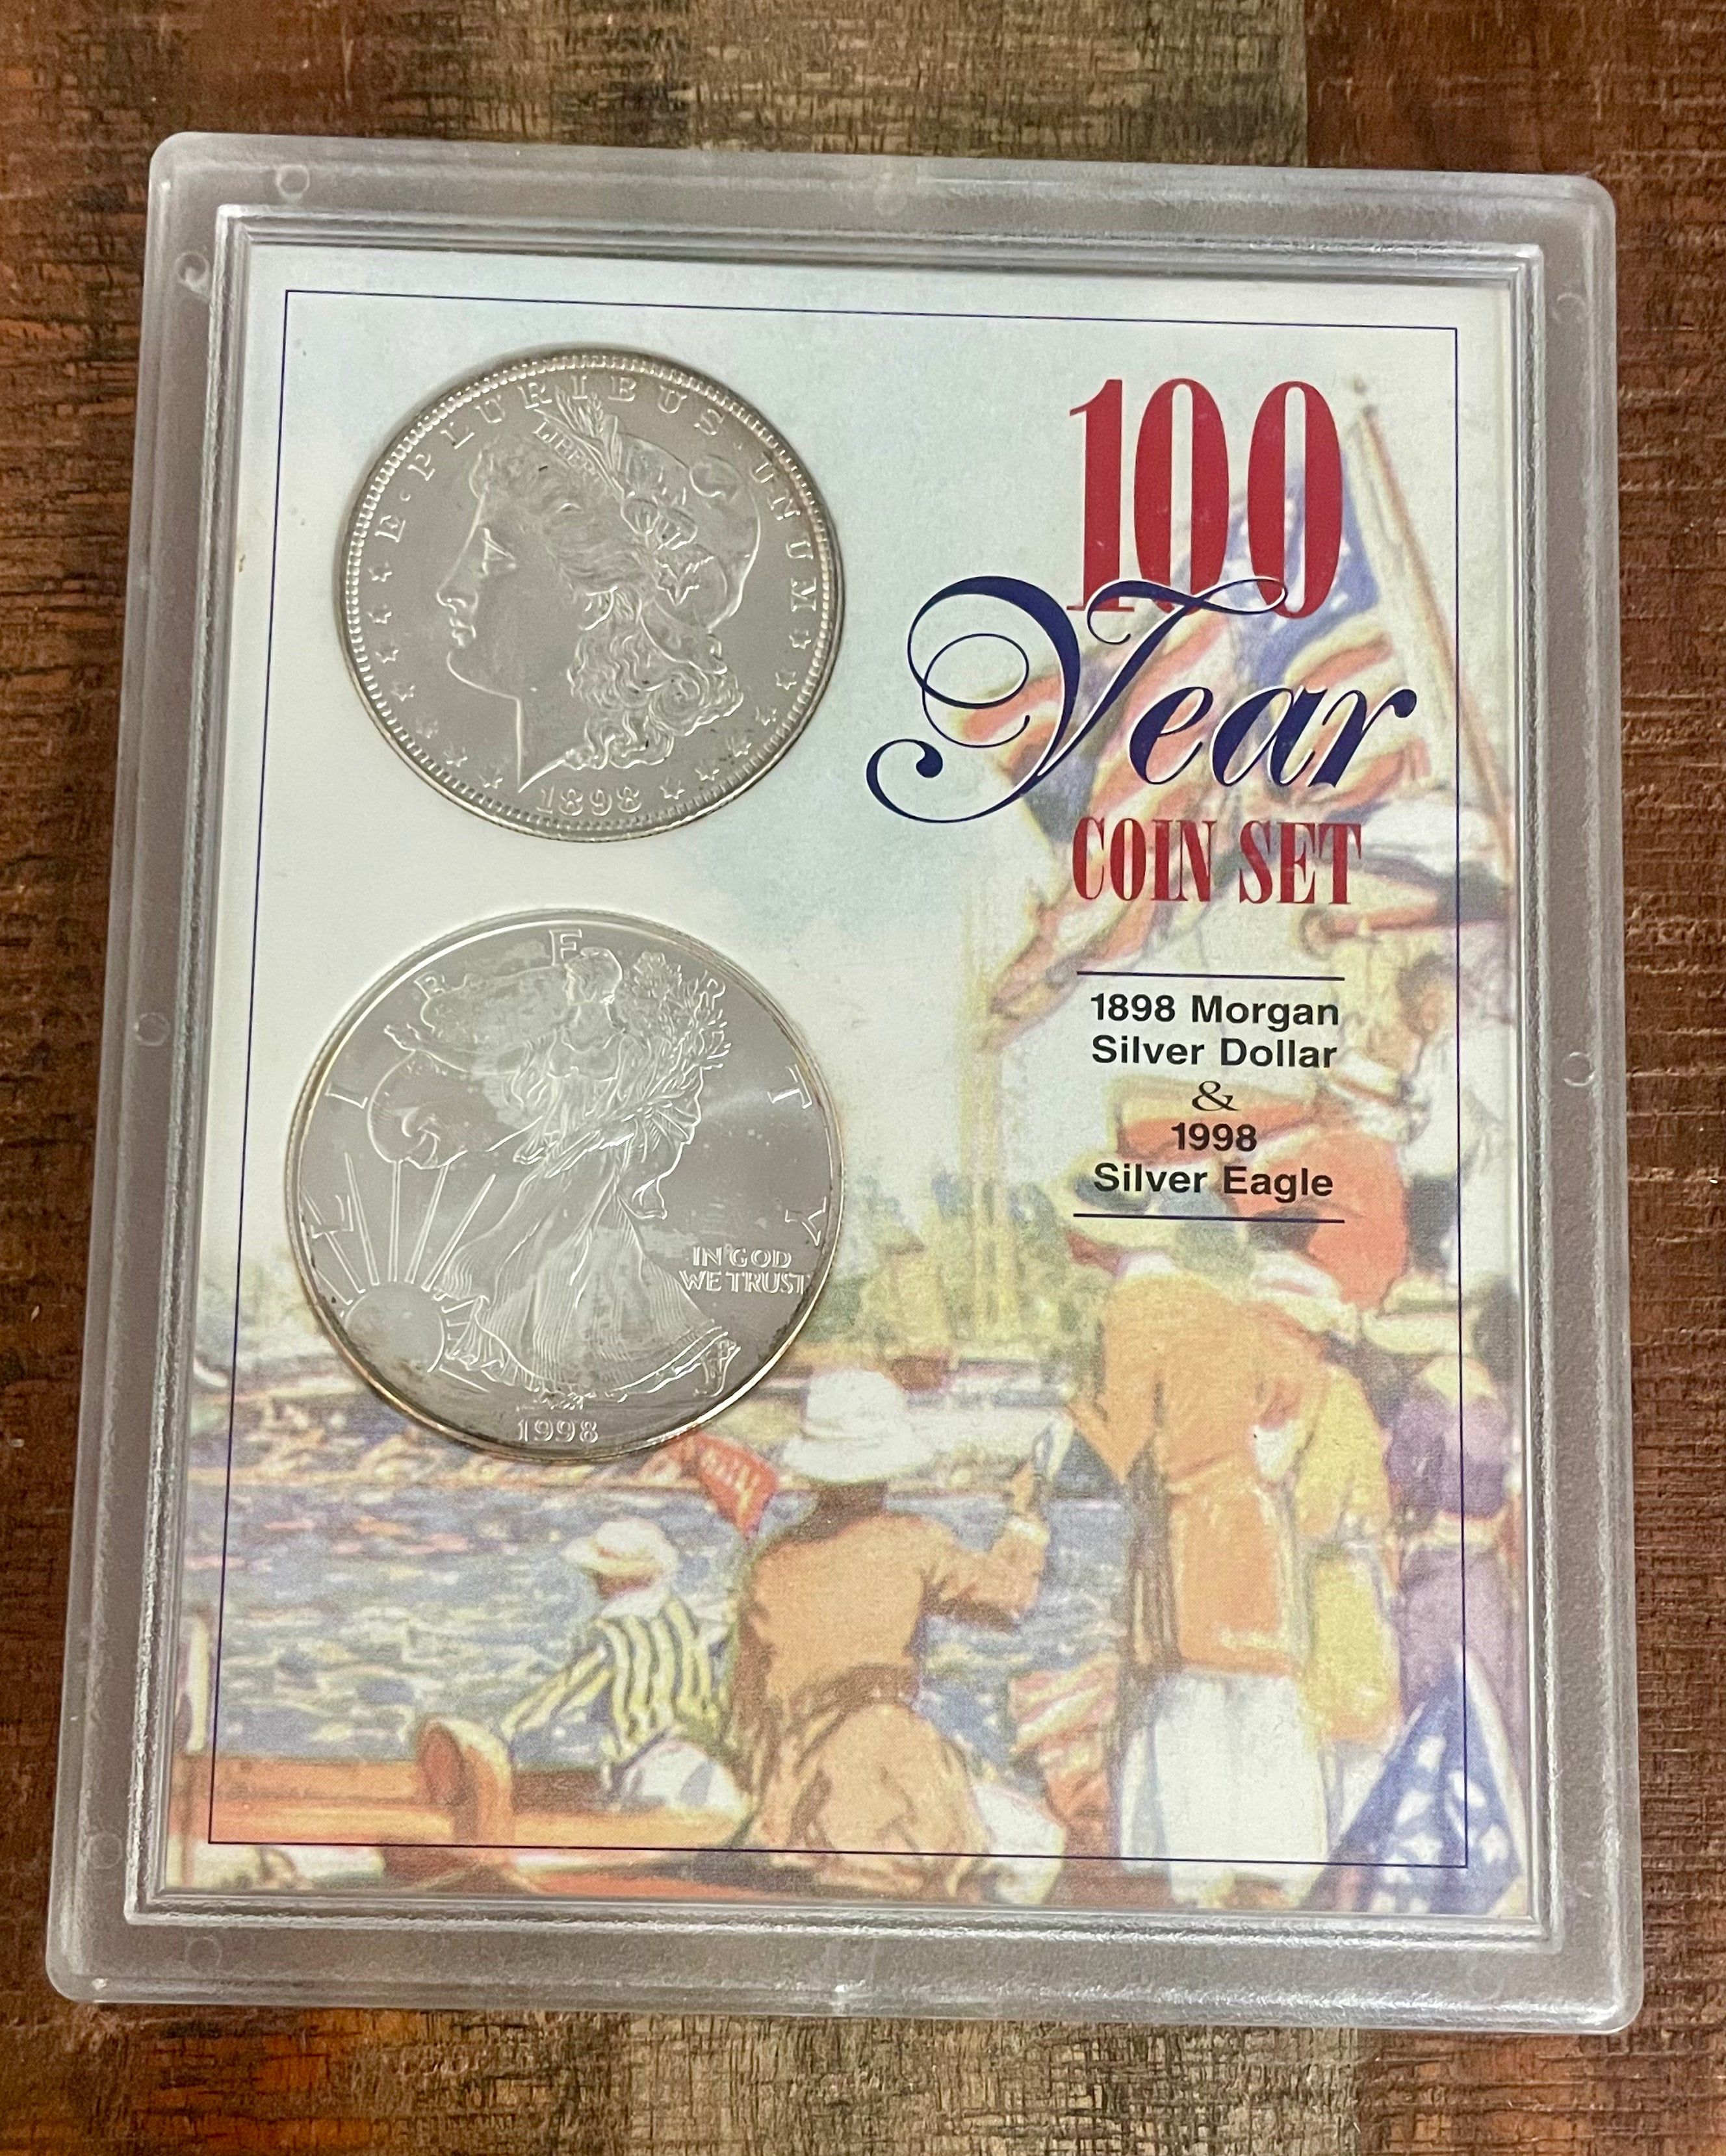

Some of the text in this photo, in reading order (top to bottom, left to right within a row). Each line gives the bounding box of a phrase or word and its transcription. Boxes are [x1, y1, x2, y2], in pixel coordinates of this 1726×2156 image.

[374, 374, 817, 612] E PLURIBUS UNUM
[1066, 378, 1343, 619] 100
[866, 575, 1417, 824] Year
[535, 786, 643, 817] 1898
[1072, 816, 1362, 906] COIN SET
[1090, 993, 1339, 1033] 1898 Morgan
[1092, 1034, 1337, 1068] Silver Dollar
[1191, 1081, 1240, 1112] &
[1170, 1122, 1257, 1153] 1998
[1094, 1162, 1334, 1204] Silver Eagle
[692, 1246, 793, 1269] IN GOD
[678, 1270, 811, 1295] WE TRUST
[517, 1418, 599, 1443] 1998
